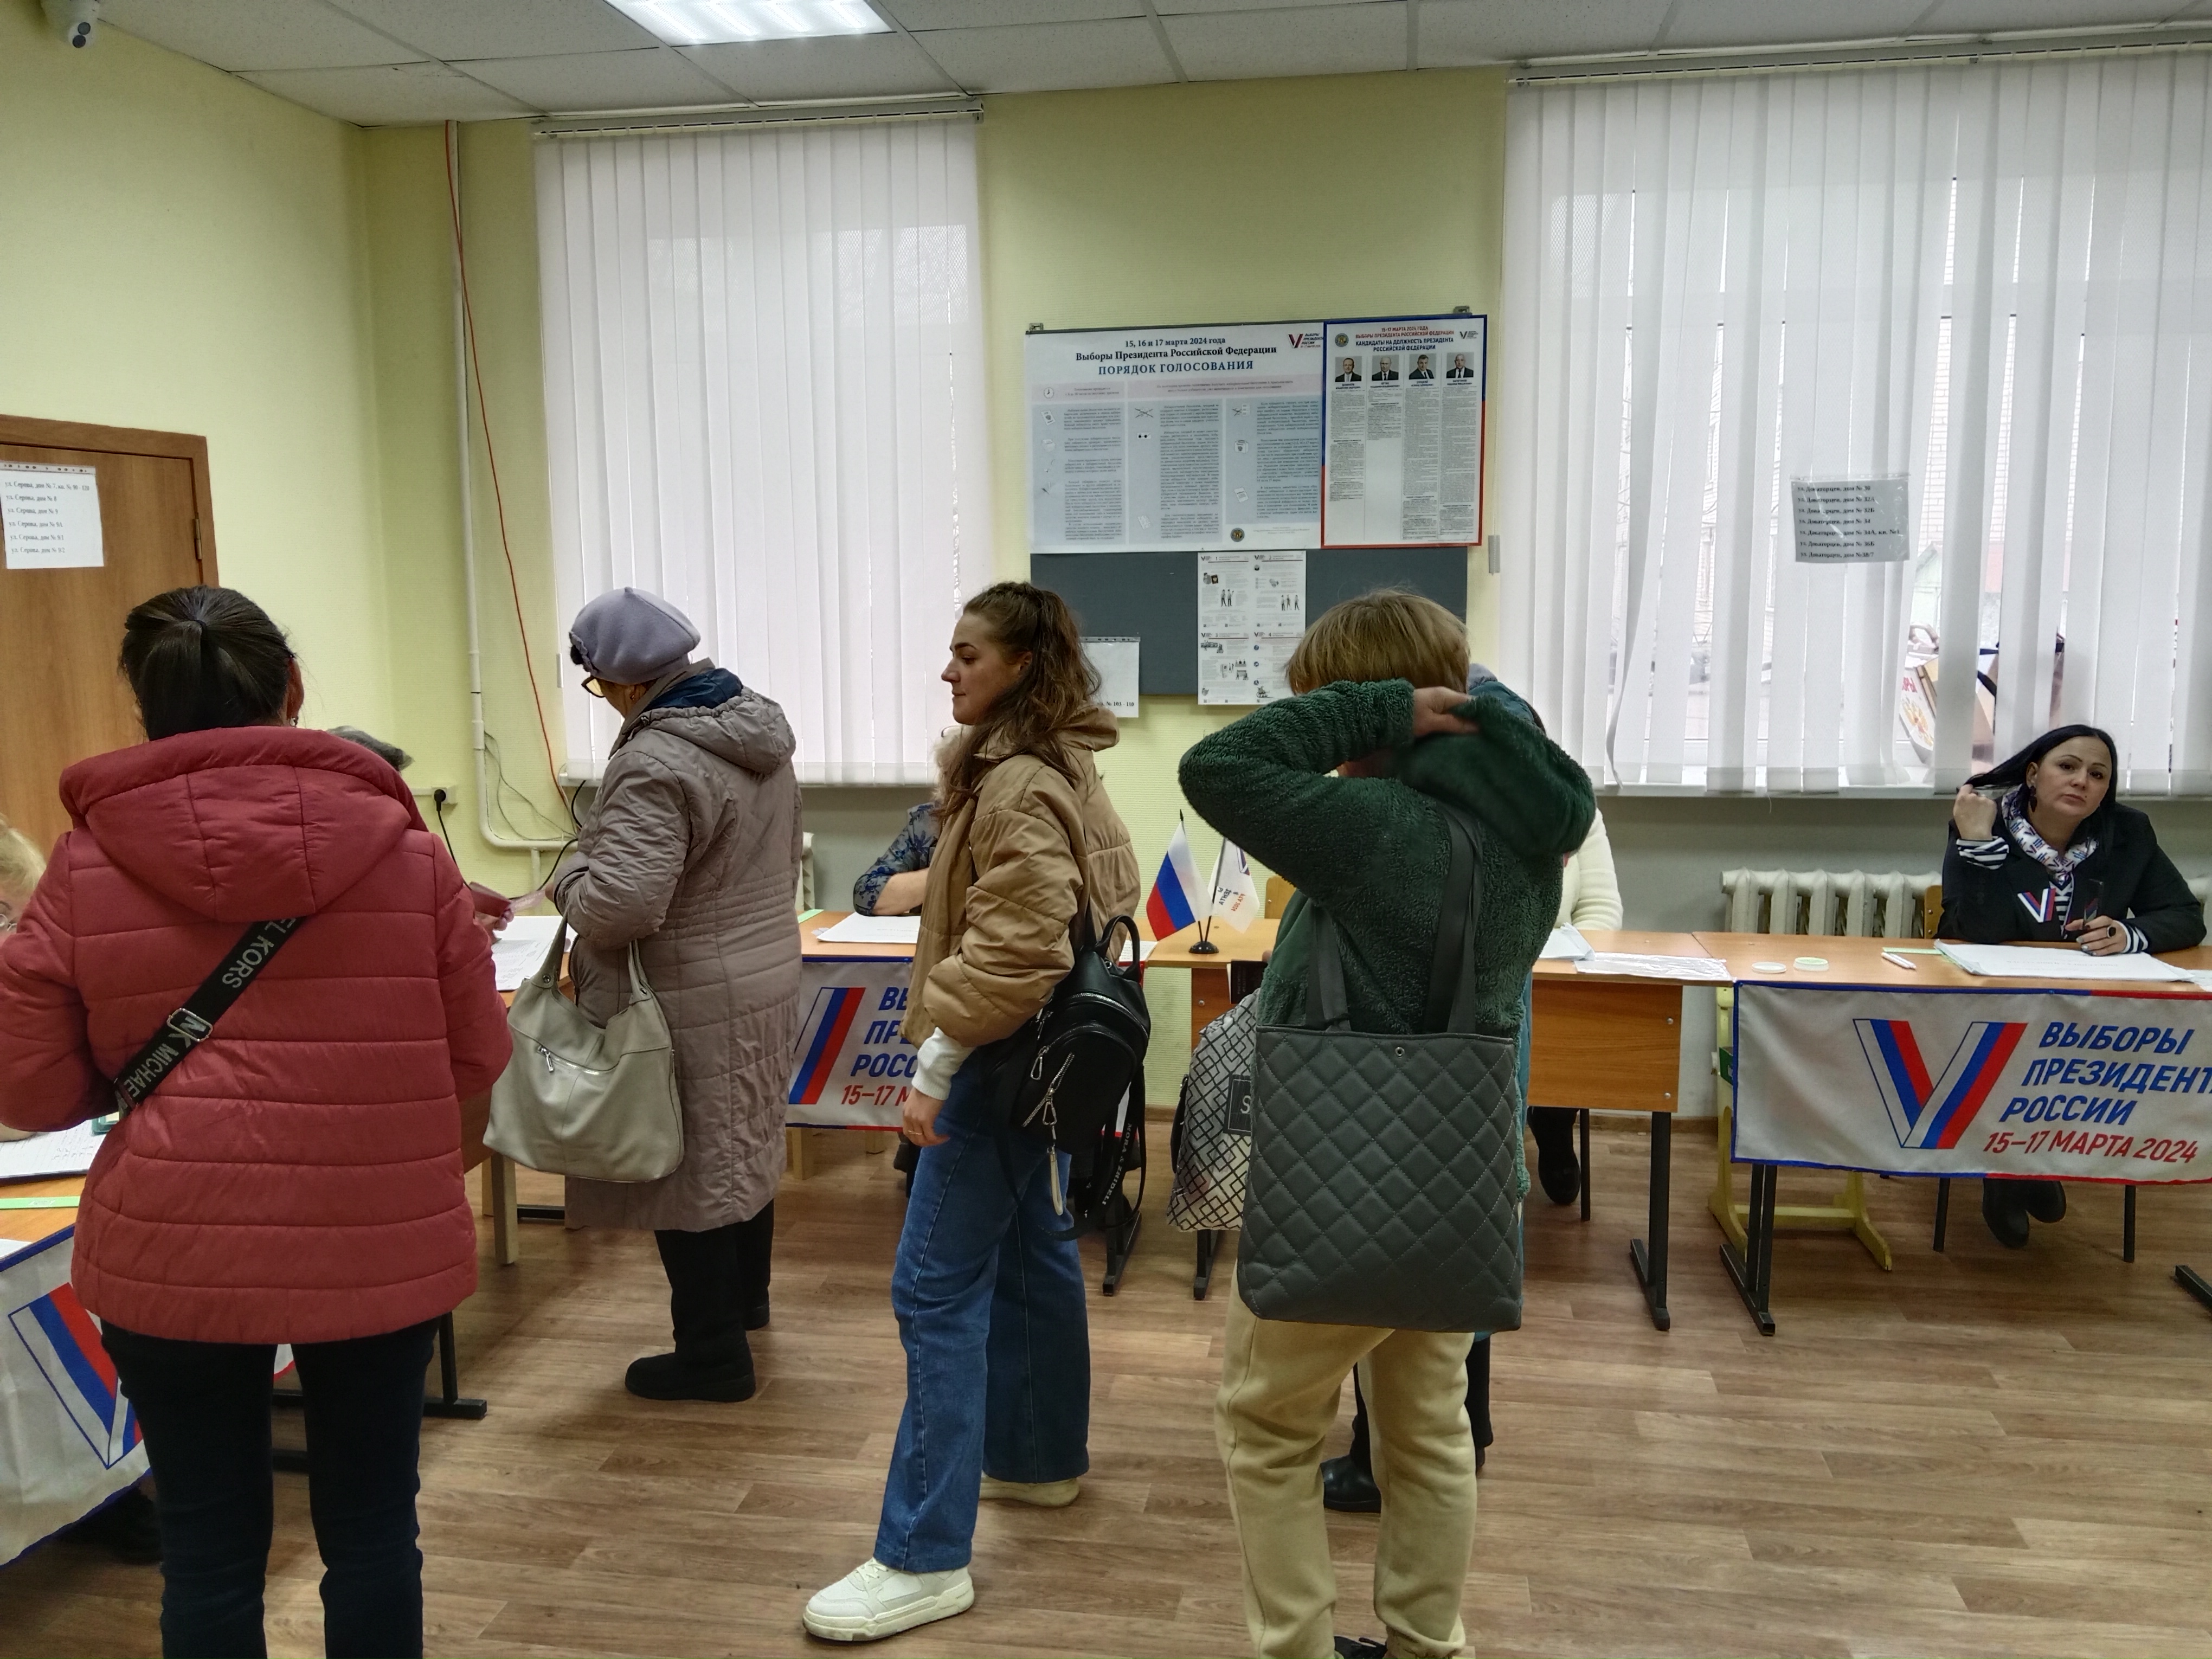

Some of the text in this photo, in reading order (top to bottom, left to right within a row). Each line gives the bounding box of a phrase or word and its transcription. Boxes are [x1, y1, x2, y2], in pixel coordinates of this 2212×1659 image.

[1076, 346, 1277, 362] Выборы Президента Российской Федерации
[1165, 339, 1188, 347] марта
[1098, 361, 1254, 375] ПОРЯДОК ГОЛОСОВАНИЯ
[222, 935, 274, 988] KORS
[2039, 1021, 2195, 1054] ВЫБОРЫ
[2021, 1058, 2212, 1094] ПРЕЗИДЕНТ
[1999, 1095, 2138, 1126] РОССИИ
[2048, 1130, 2134, 1157] МАРТА
[2133, 1138, 2198, 1163] 2024
